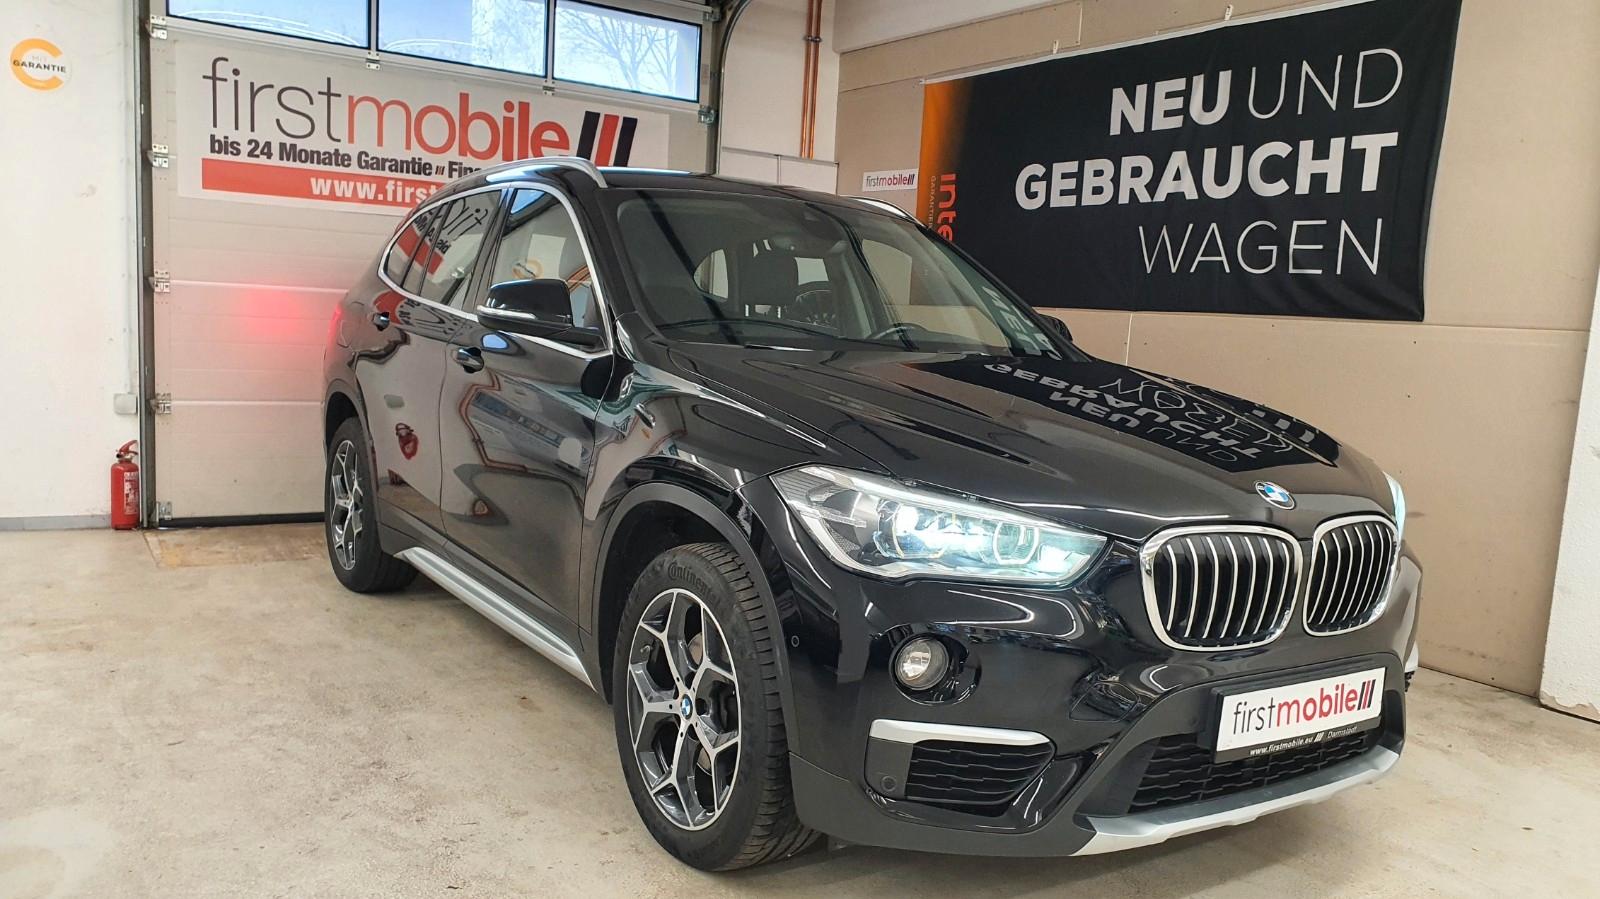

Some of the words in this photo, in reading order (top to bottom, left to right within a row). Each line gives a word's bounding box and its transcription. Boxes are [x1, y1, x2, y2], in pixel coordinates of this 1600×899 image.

[13, 59, 67, 73] GARANTIE
[1109, 70, 1232, 136] NEU
[1248, 48, 1403, 119] UND
[202, 57, 570, 162] firstmobile
[210, 134, 242, 156] bis
[247, 139, 274, 160] 24
[279, 142, 352, 168] Monate
[357, 150, 433, 176] Garantie
[866, 173, 908, 187] firstmobile
[1014, 131, 1399, 211] GEBRAUCHT
[1138, 217, 1382, 276] WAGEN
[1233, 683, 1358, 735] firstmobile
[1250, 736, 1314, 756] www.firstmobile.eu
